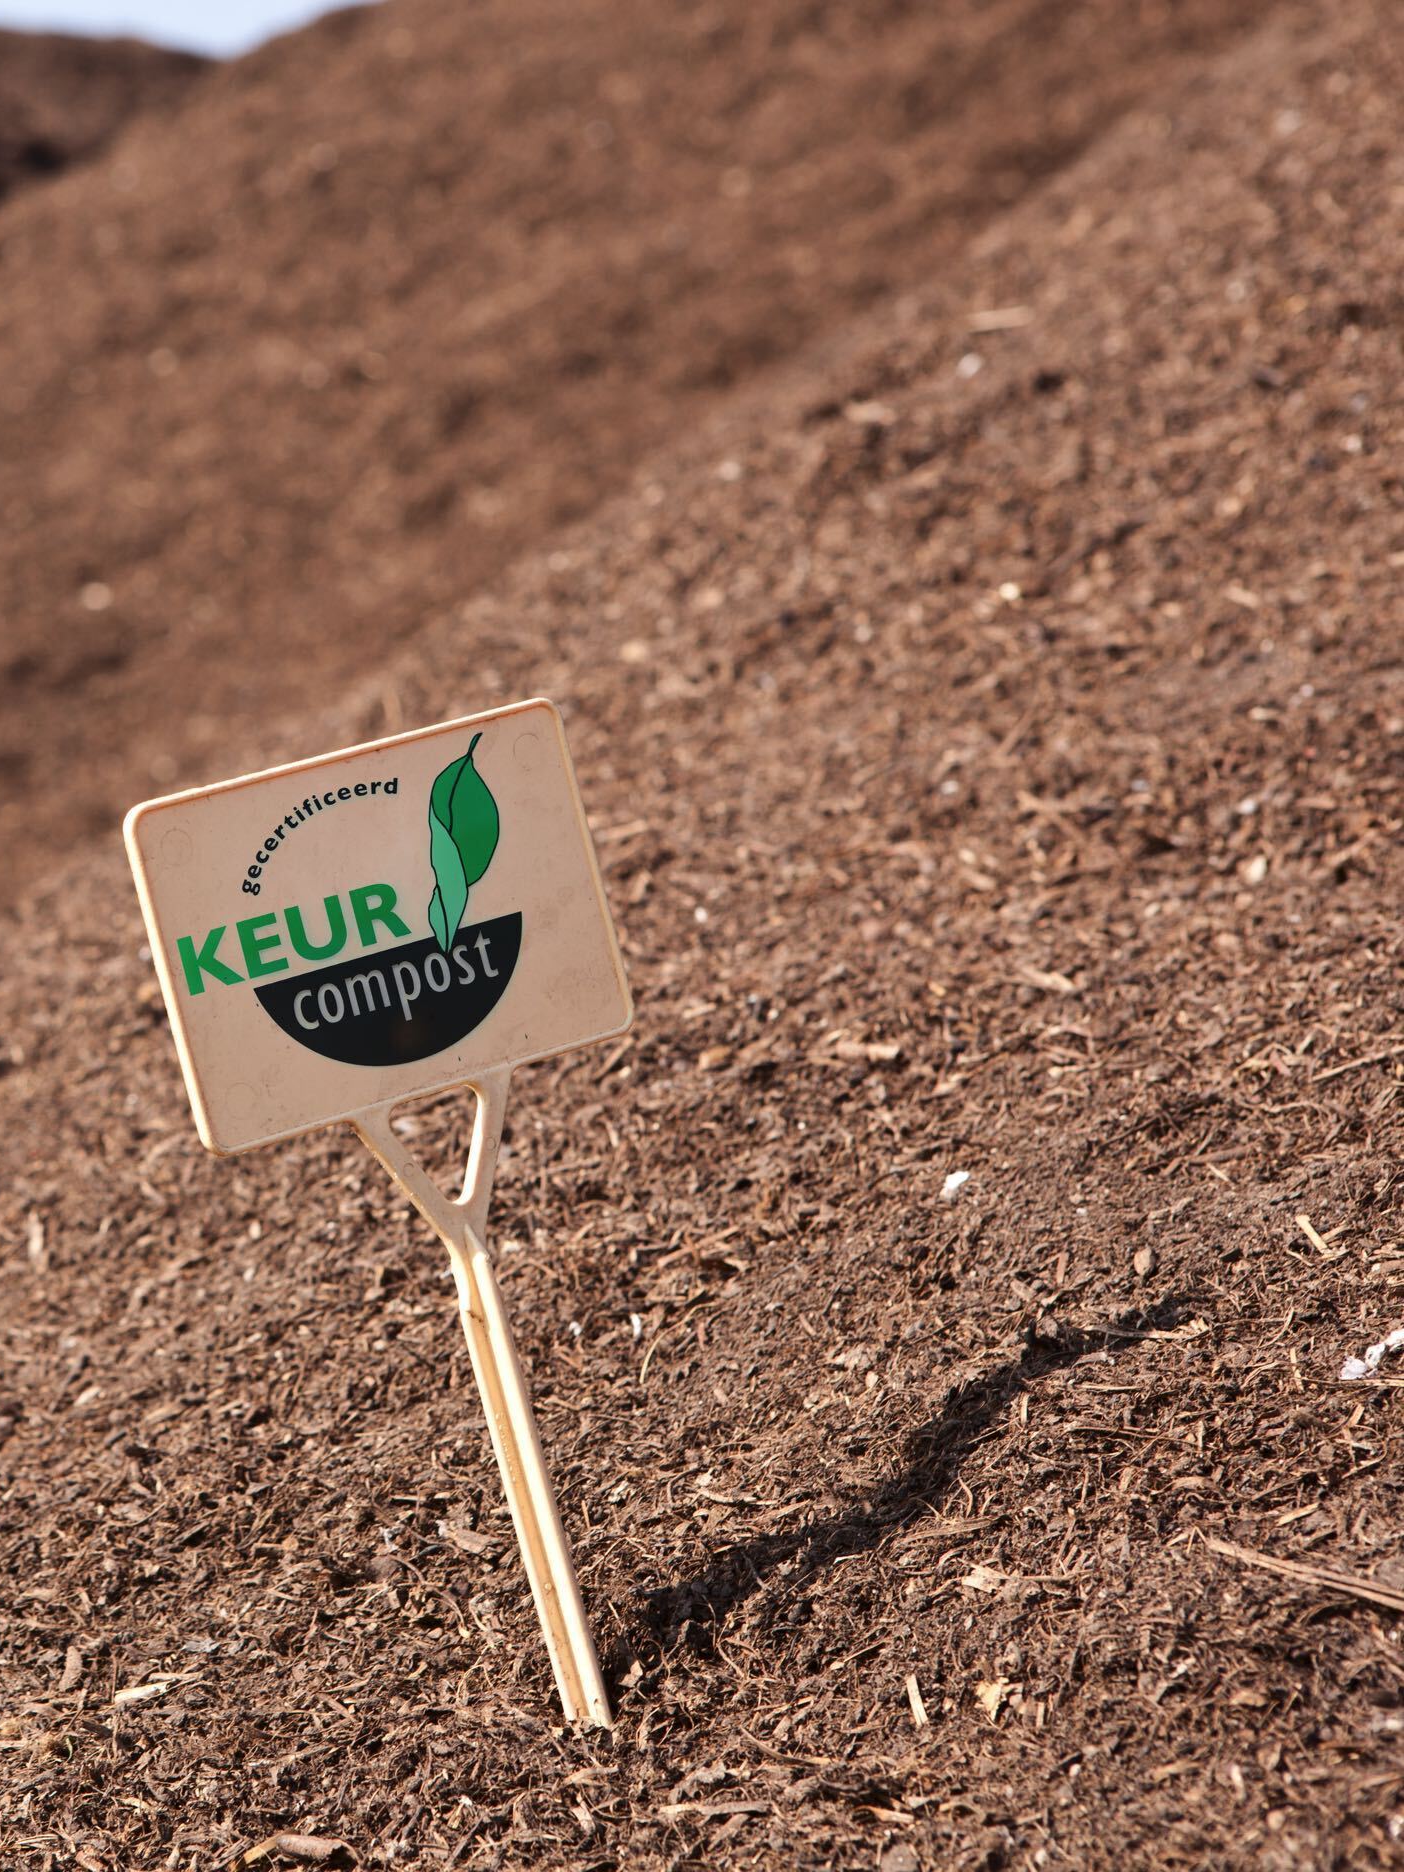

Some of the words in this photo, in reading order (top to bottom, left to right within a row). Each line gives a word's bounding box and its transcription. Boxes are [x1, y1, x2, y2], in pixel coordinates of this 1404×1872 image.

[242, 777, 399, 896] gecertificeerd
[176, 883, 412, 996] KEUR
[294, 931, 499, 1030] compost
